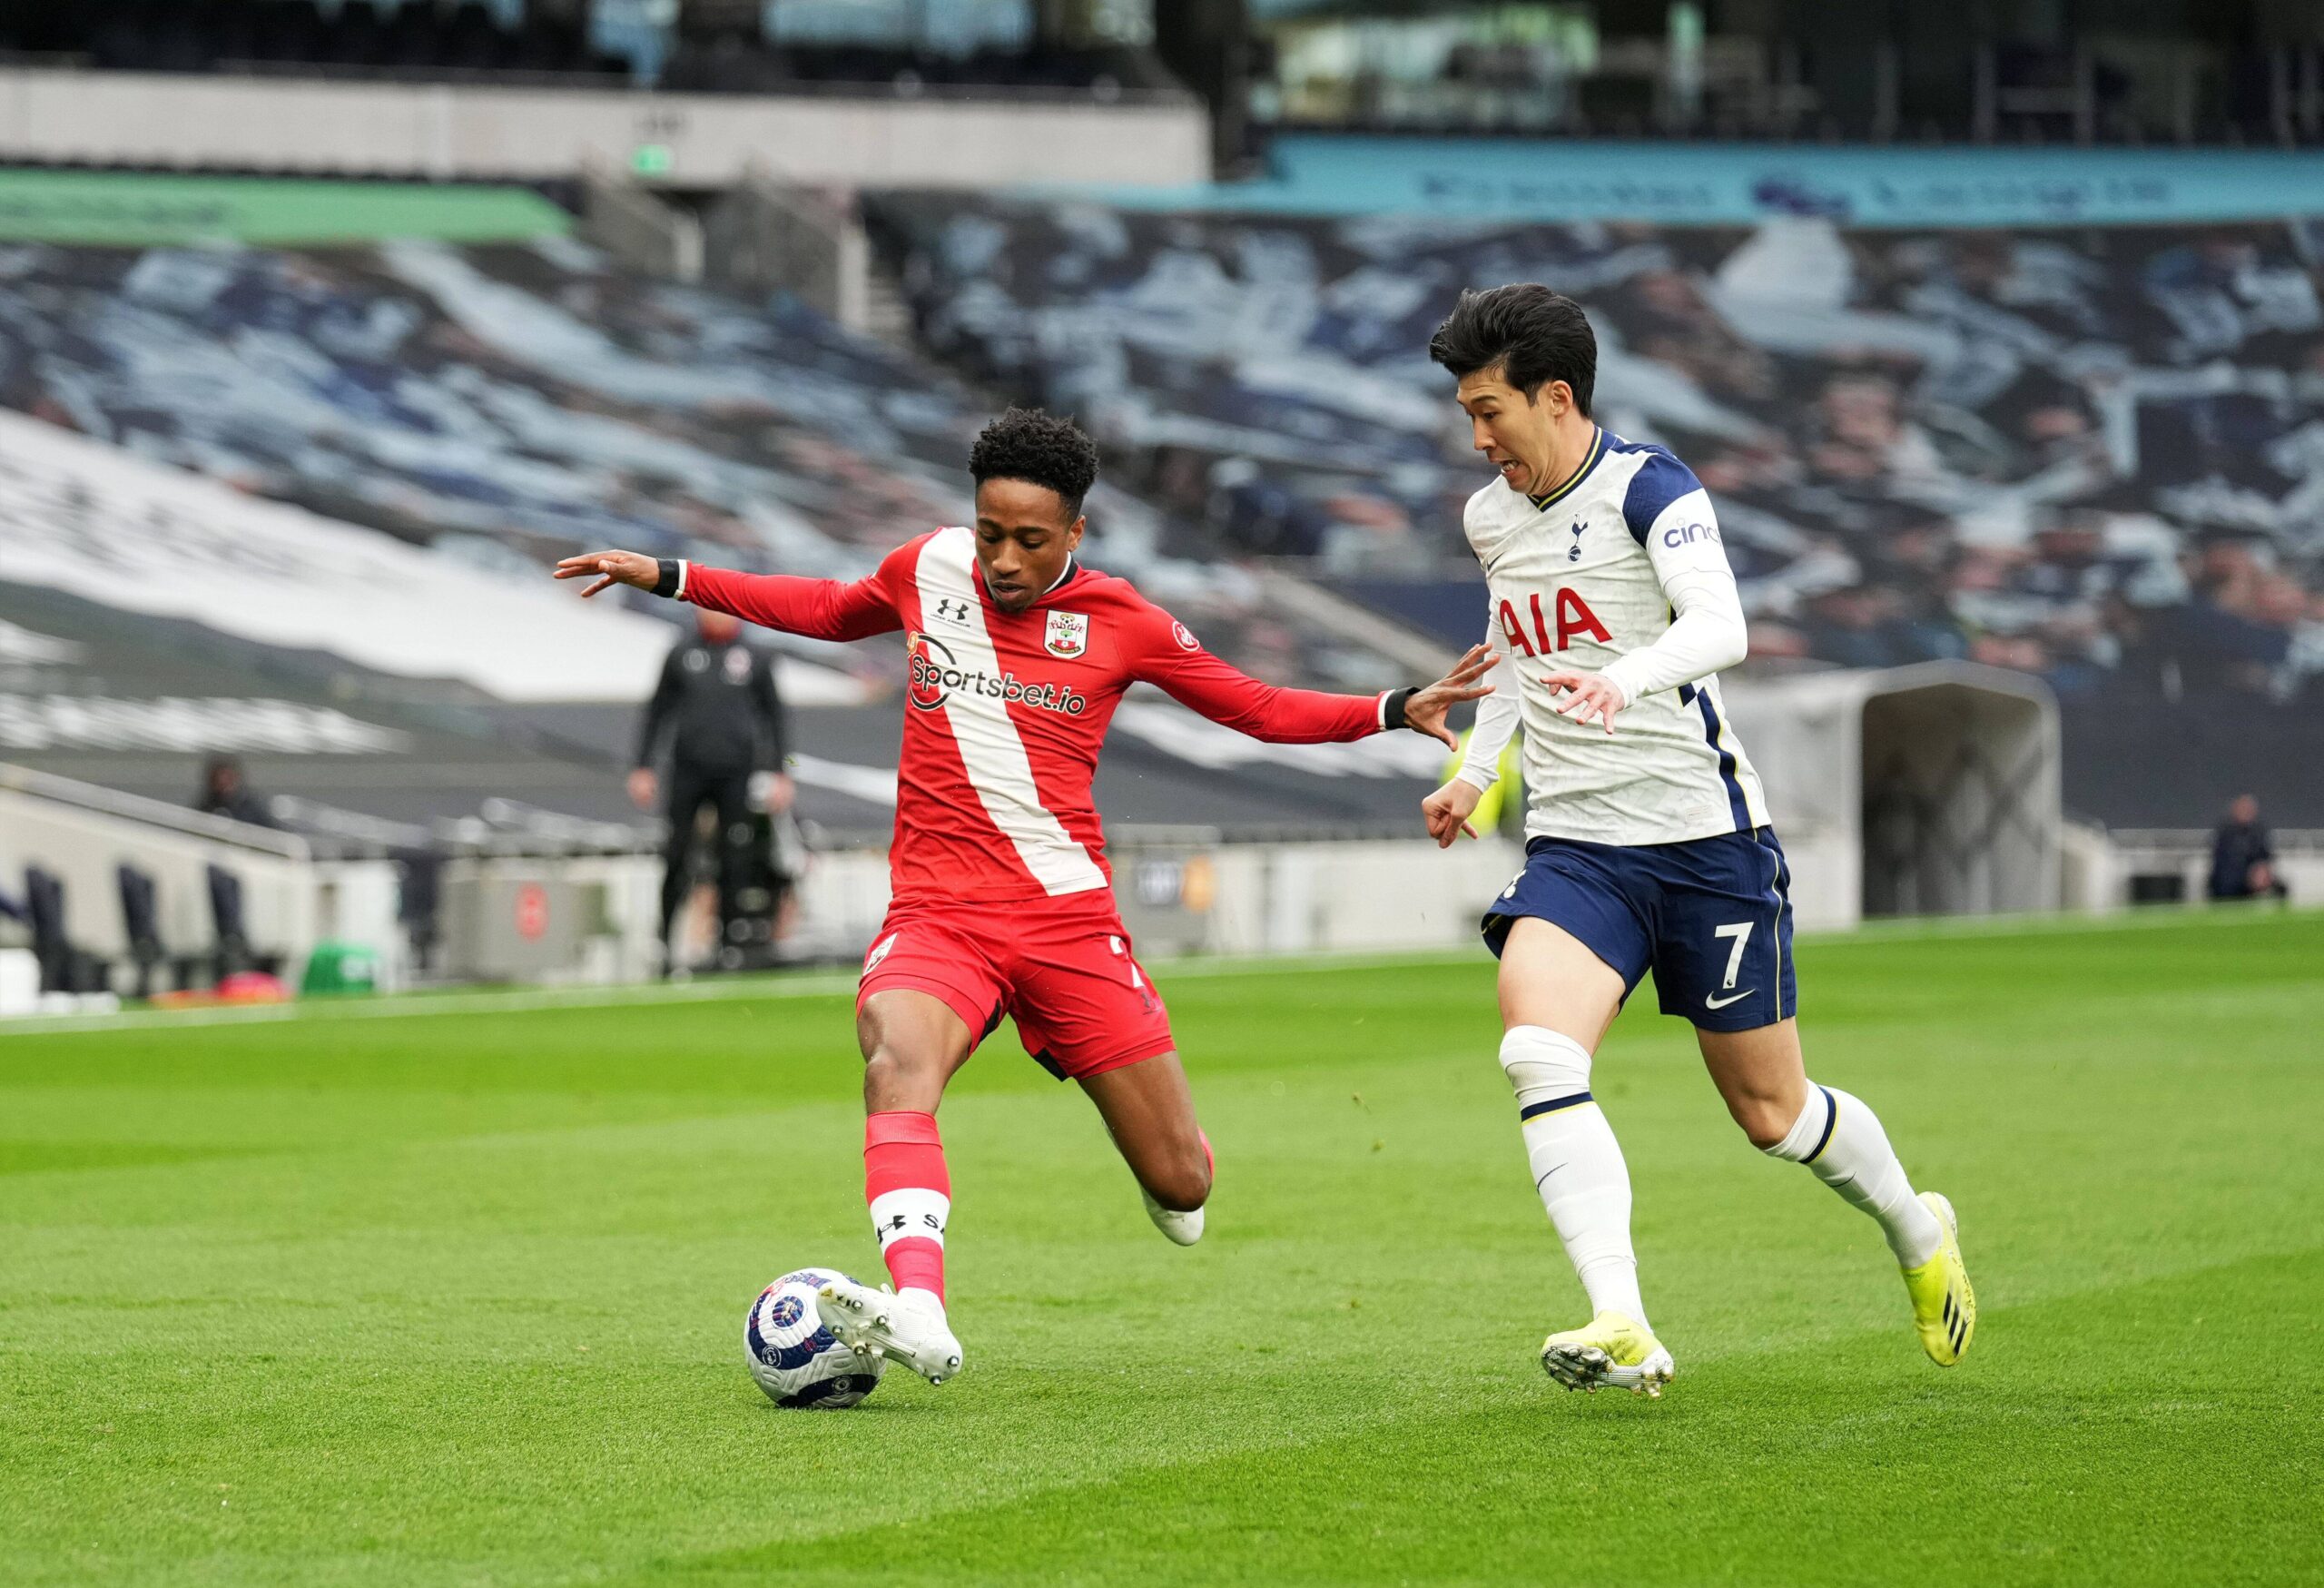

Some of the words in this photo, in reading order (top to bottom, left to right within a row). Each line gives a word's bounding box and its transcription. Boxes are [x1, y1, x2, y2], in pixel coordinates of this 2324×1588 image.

[1500, 587, 1612, 657] AIA
[911, 655, 1087, 715] Sportsbet.io
[1715, 922, 1754, 989] 7
